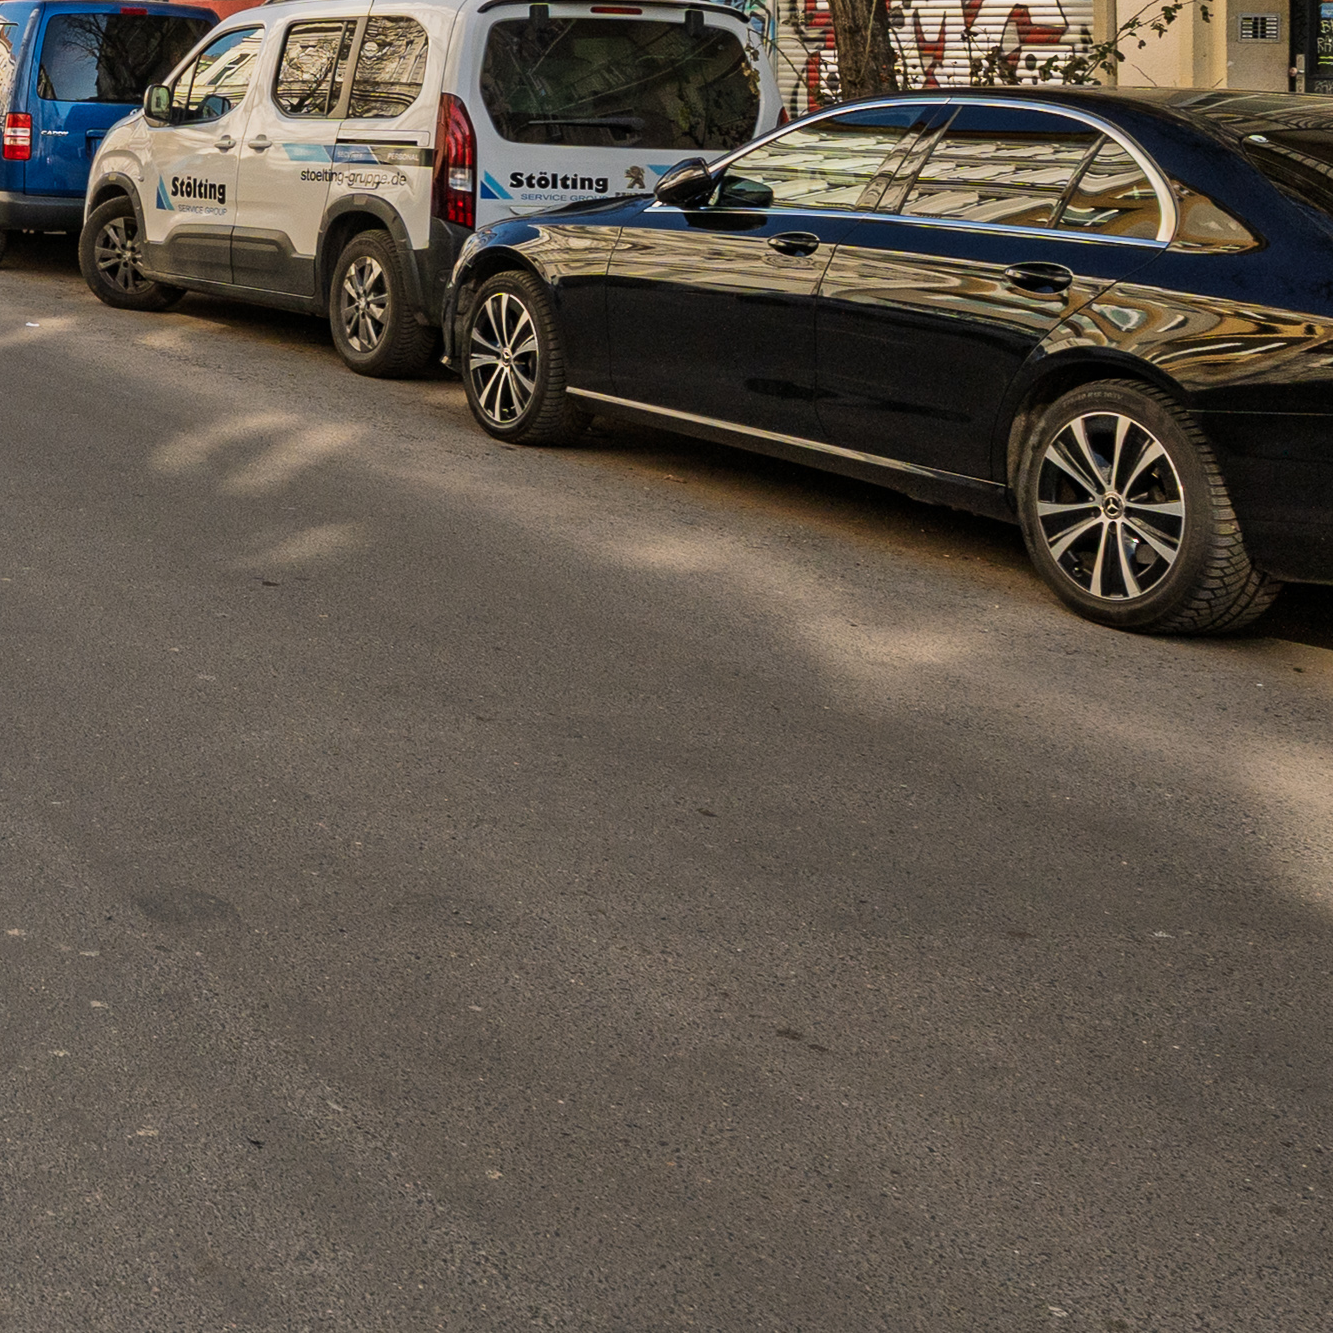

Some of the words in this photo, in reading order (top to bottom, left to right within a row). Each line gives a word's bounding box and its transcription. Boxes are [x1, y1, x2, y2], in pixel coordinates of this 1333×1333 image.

[40, 129, 70, 137] CADDY
[386, 152, 420, 162] PERSONAL
[300, 168, 407, 187] stoelting-gruppe.de
[509, 171, 609, 193] Stölting
[171, 176, 226, 205] Stölting
[520, 193, 567, 202] SERVICE
[177, 204, 204, 214] SERVICE
[205, 206, 228, 216] GROUP
